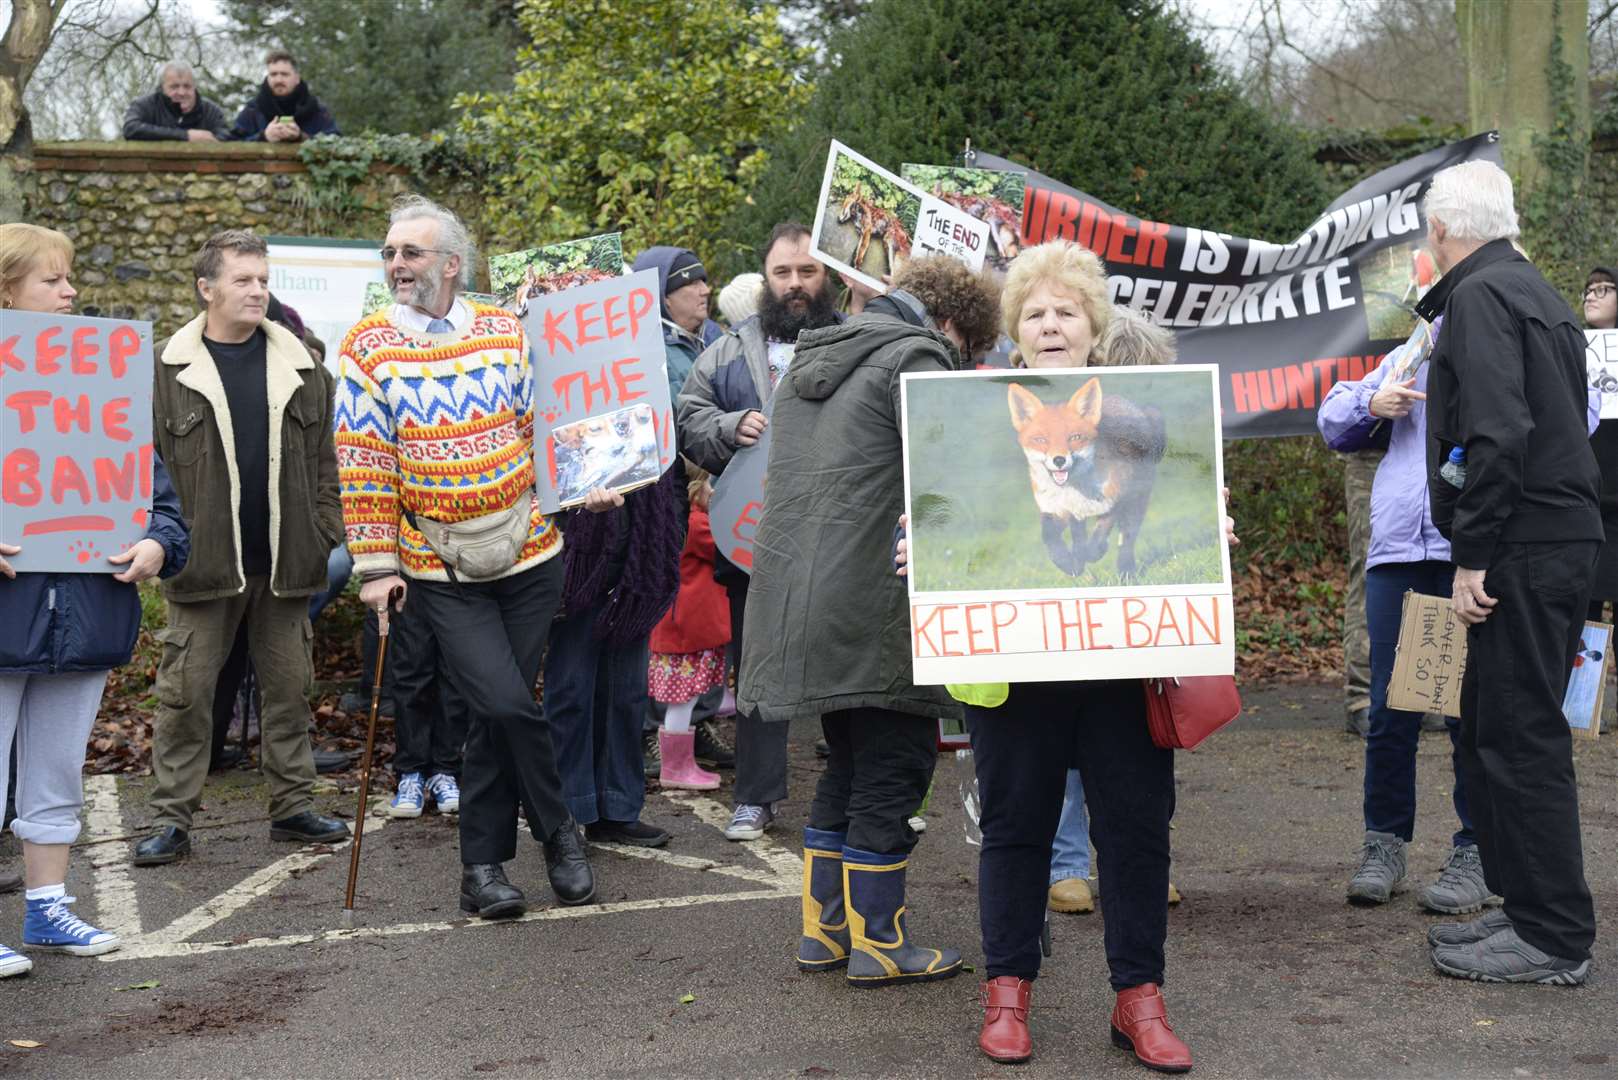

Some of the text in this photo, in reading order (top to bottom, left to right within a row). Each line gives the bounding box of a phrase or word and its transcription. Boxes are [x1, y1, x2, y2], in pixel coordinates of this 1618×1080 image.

[926, 209, 951, 236] THE
[952, 223, 980, 252] END
[938, 236, 950, 249] OF
[952, 242, 964, 256] THE
[1020, 182, 1422, 276] URDER IS NOTHING
[270, 268, 328, 292] lham
[1107, 257, 1356, 328] CELEBRATE
[540, 286, 653, 357] KEEP
[552, 357, 649, 414] THE
[5, 390, 134, 442] THE
[912, 596, 1221, 657] KEEP THE BAN
[1420, 604, 1439, 649] THINK
